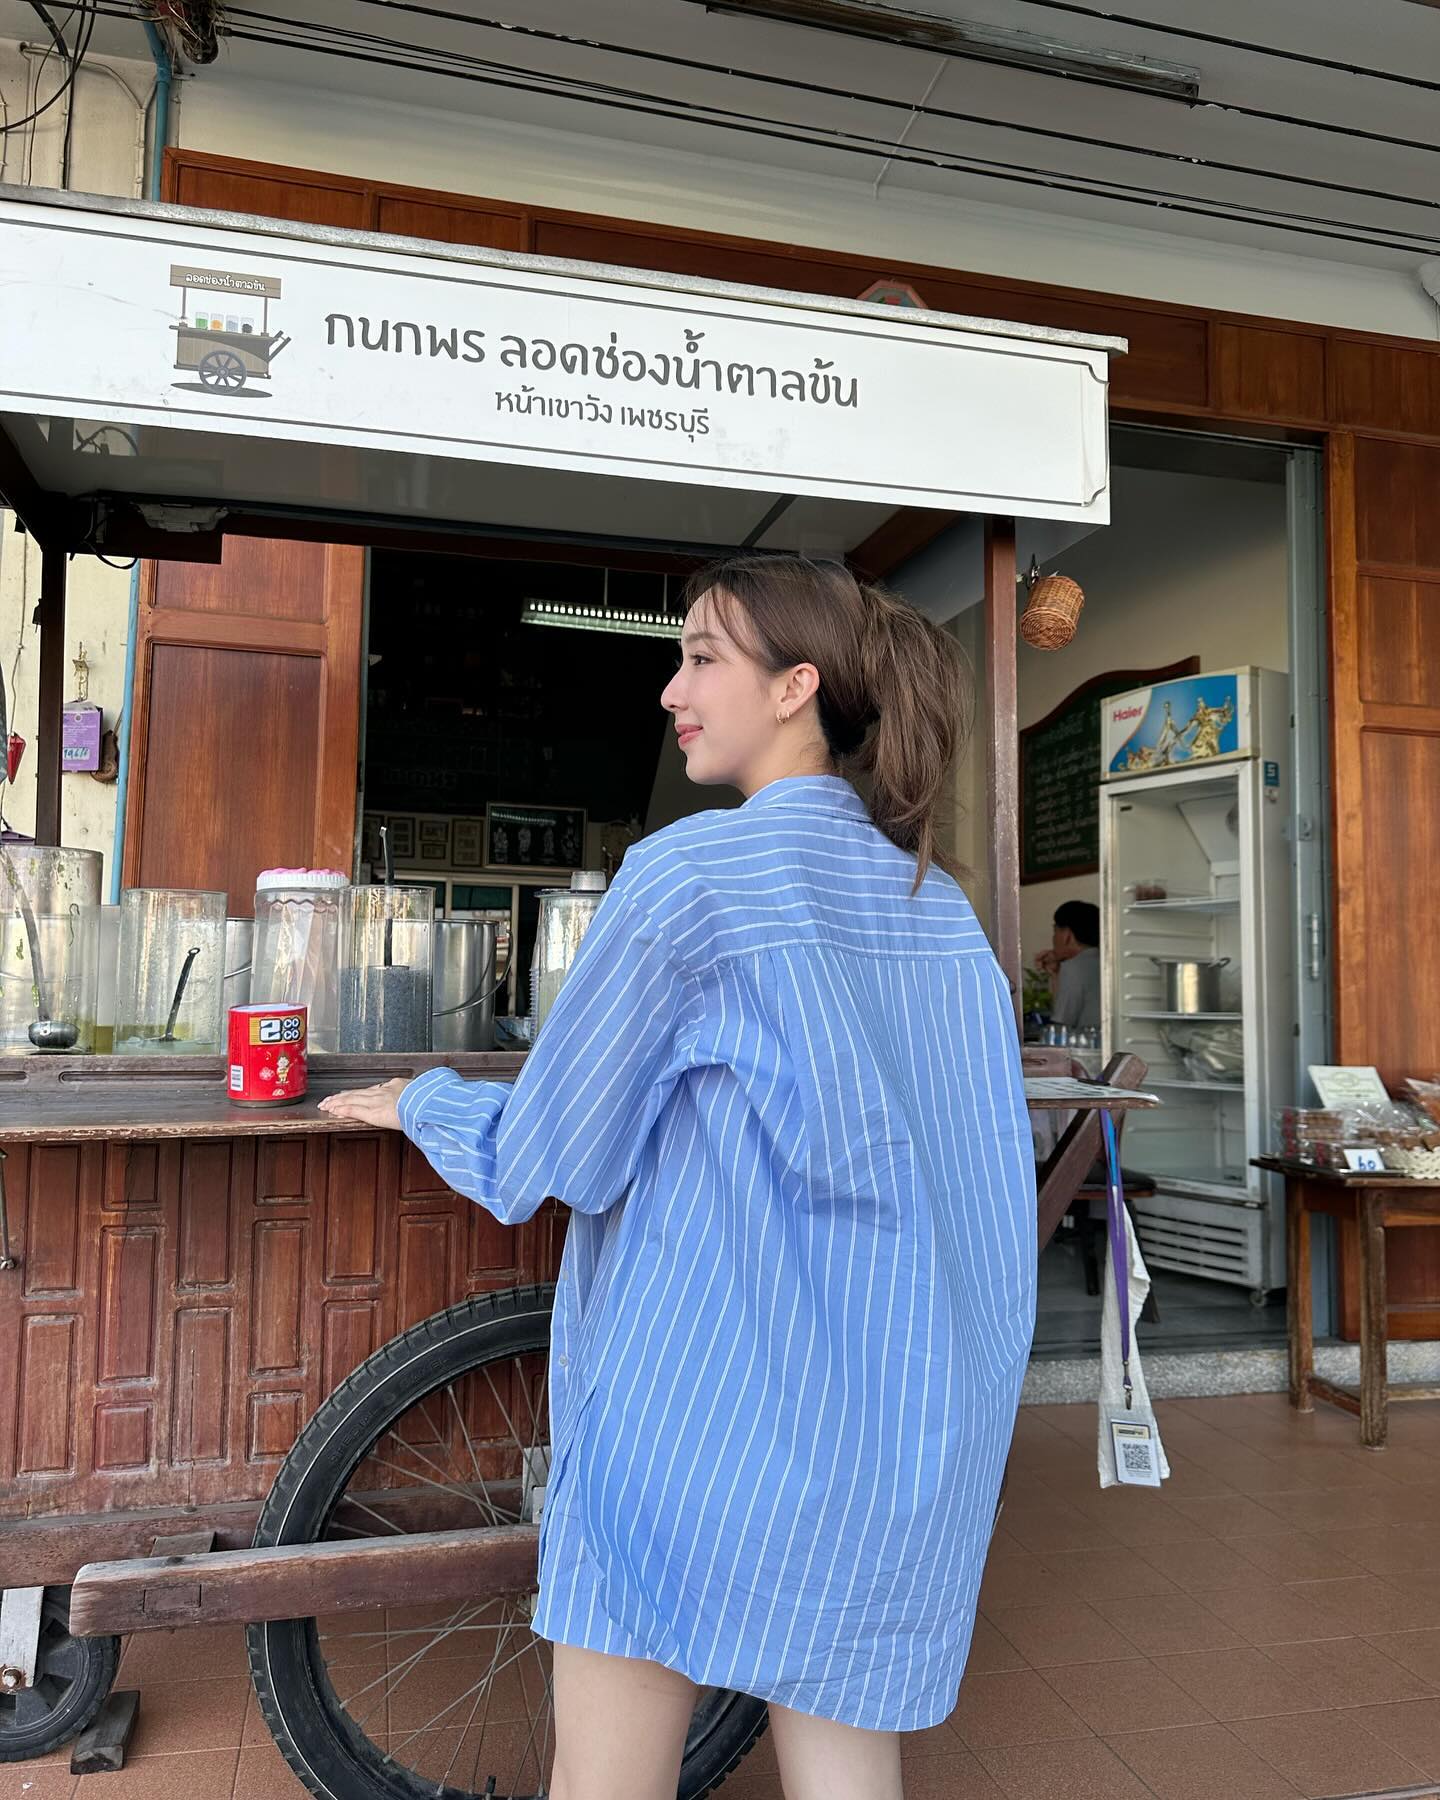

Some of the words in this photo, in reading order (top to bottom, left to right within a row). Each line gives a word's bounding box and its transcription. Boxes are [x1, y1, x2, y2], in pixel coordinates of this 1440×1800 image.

[325, 313, 485, 363] กนกพร
[500, 328, 858, 408] ลอดช่องน้ำตาลข้น
[495, 384, 612, 424] หน้าเขาวัง
[621, 405, 710, 443] เพชรบุรี
[1113, 705, 1144, 722] Haier
